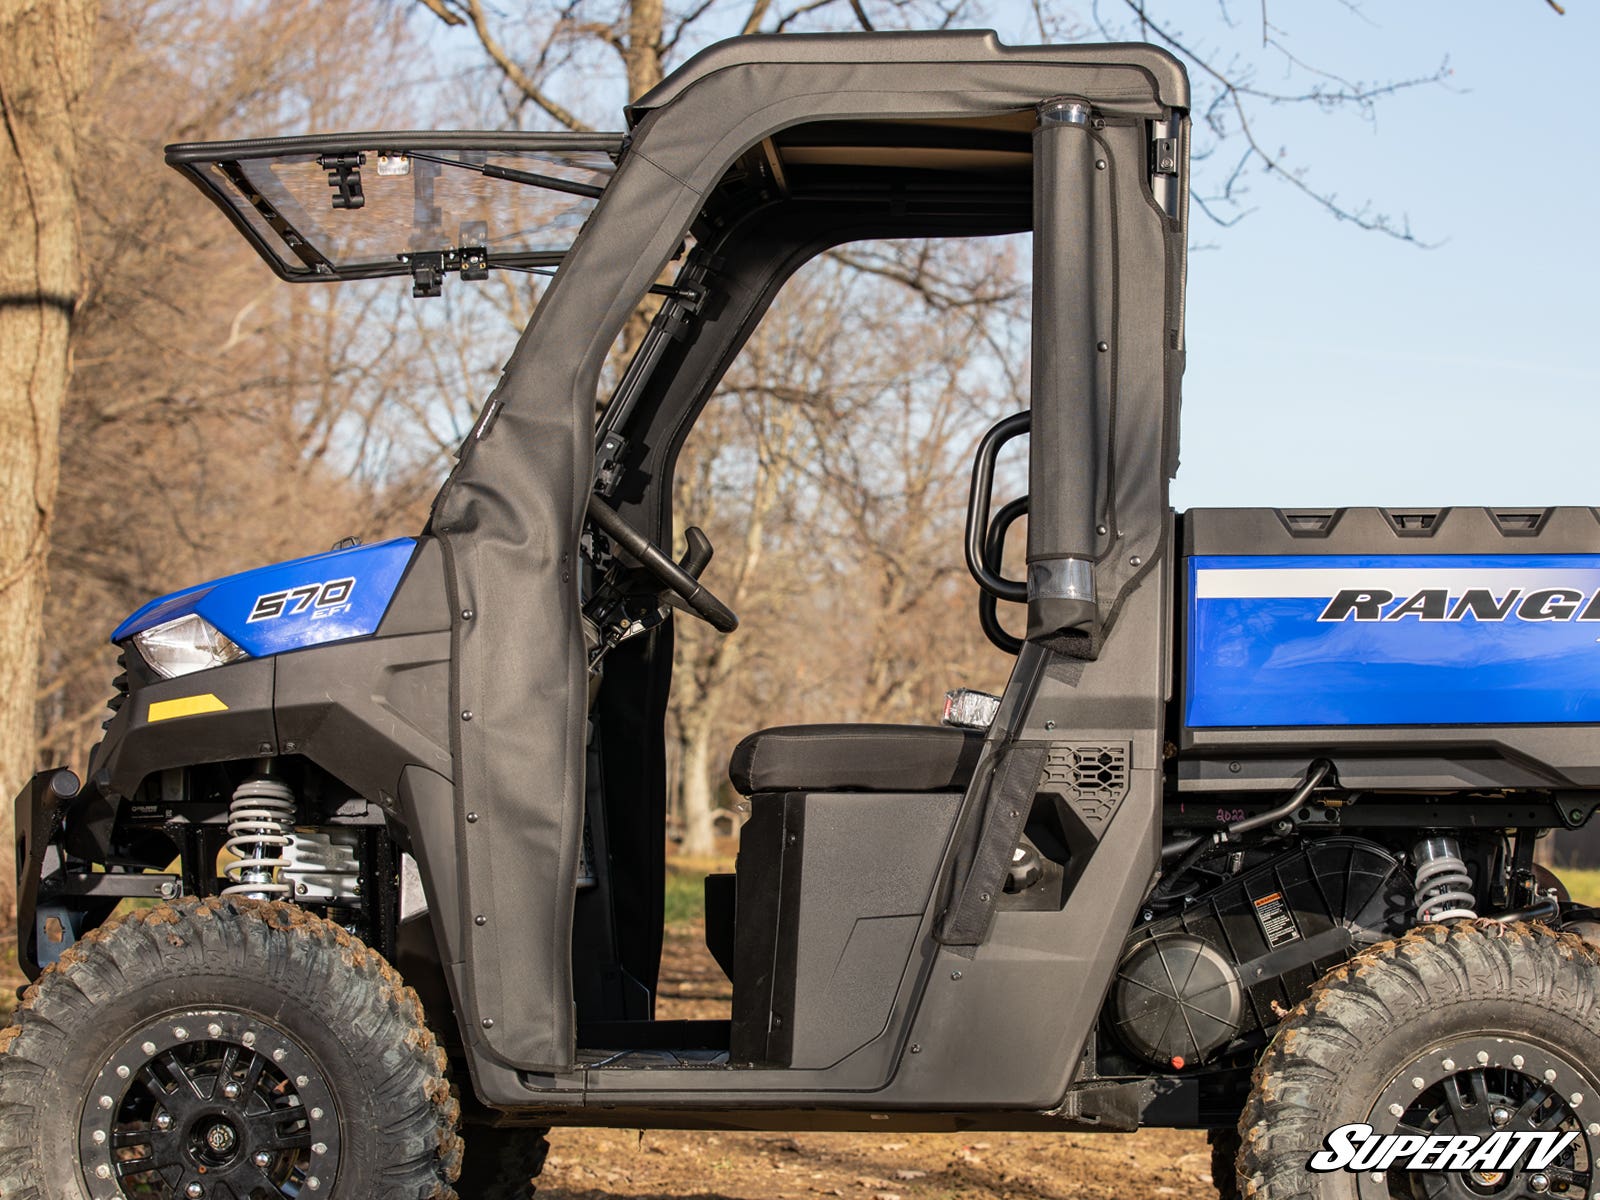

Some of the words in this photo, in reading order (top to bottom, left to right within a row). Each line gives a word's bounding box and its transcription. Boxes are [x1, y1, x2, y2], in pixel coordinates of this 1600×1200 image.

[246, 576, 356, 624] 570
[310, 604, 352, 620] EFI
[1216, 807, 1245, 822] 2022
